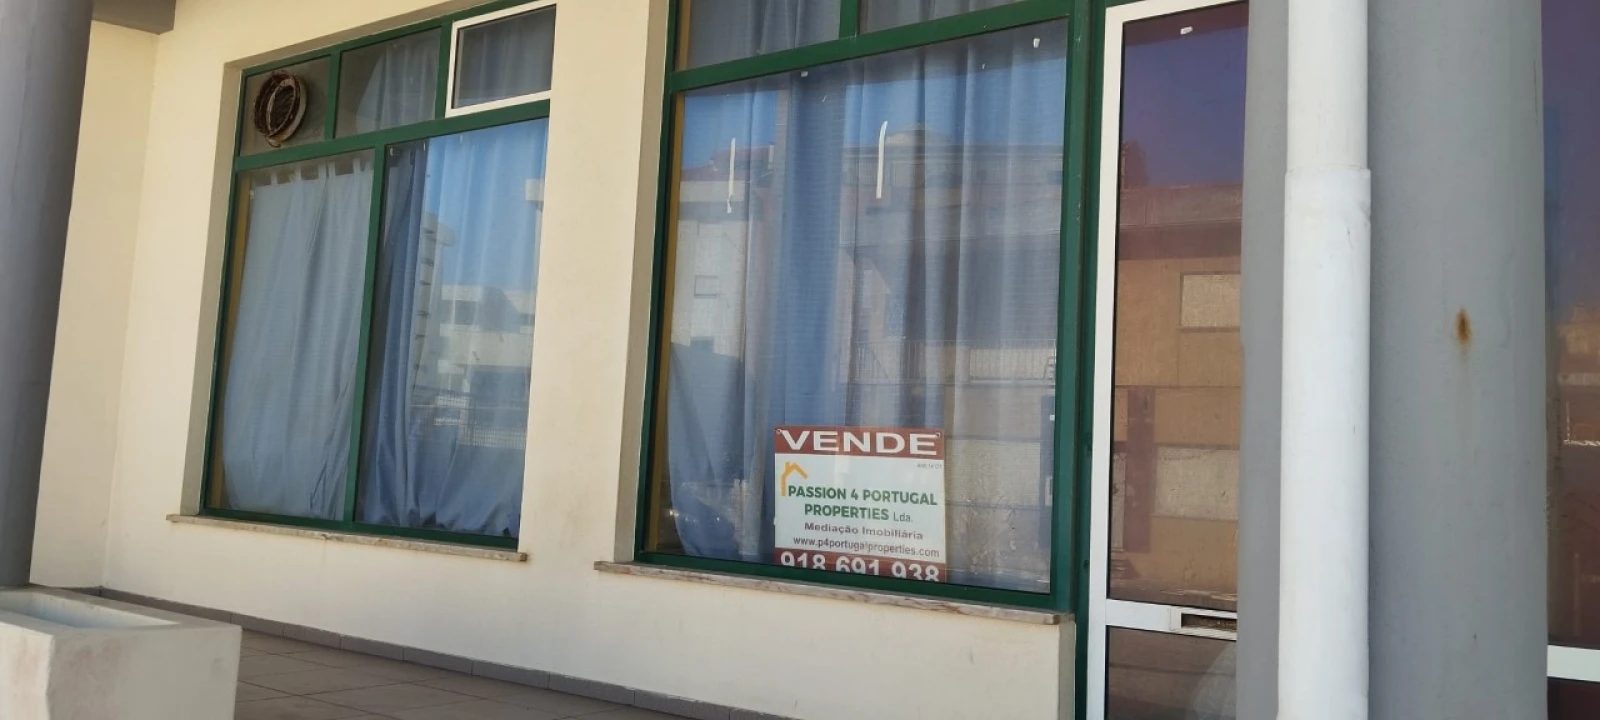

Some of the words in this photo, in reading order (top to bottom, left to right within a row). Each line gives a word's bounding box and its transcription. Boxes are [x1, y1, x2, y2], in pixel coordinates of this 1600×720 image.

[781, 429, 938, 456] VENDE
[788, 485, 846, 500] PASSION
[850, 488, 859, 501] 4
[863, 489, 938, 506] PORTUGAL
[804, 503, 889, 520] PROPERTIES
[893, 511, 913, 523] Lda.
[804, 522, 859, 535] Mediação
[862, 526, 924, 540] Imobiliária
[793, 537, 940, 558] www.p4portugalproperties.com
